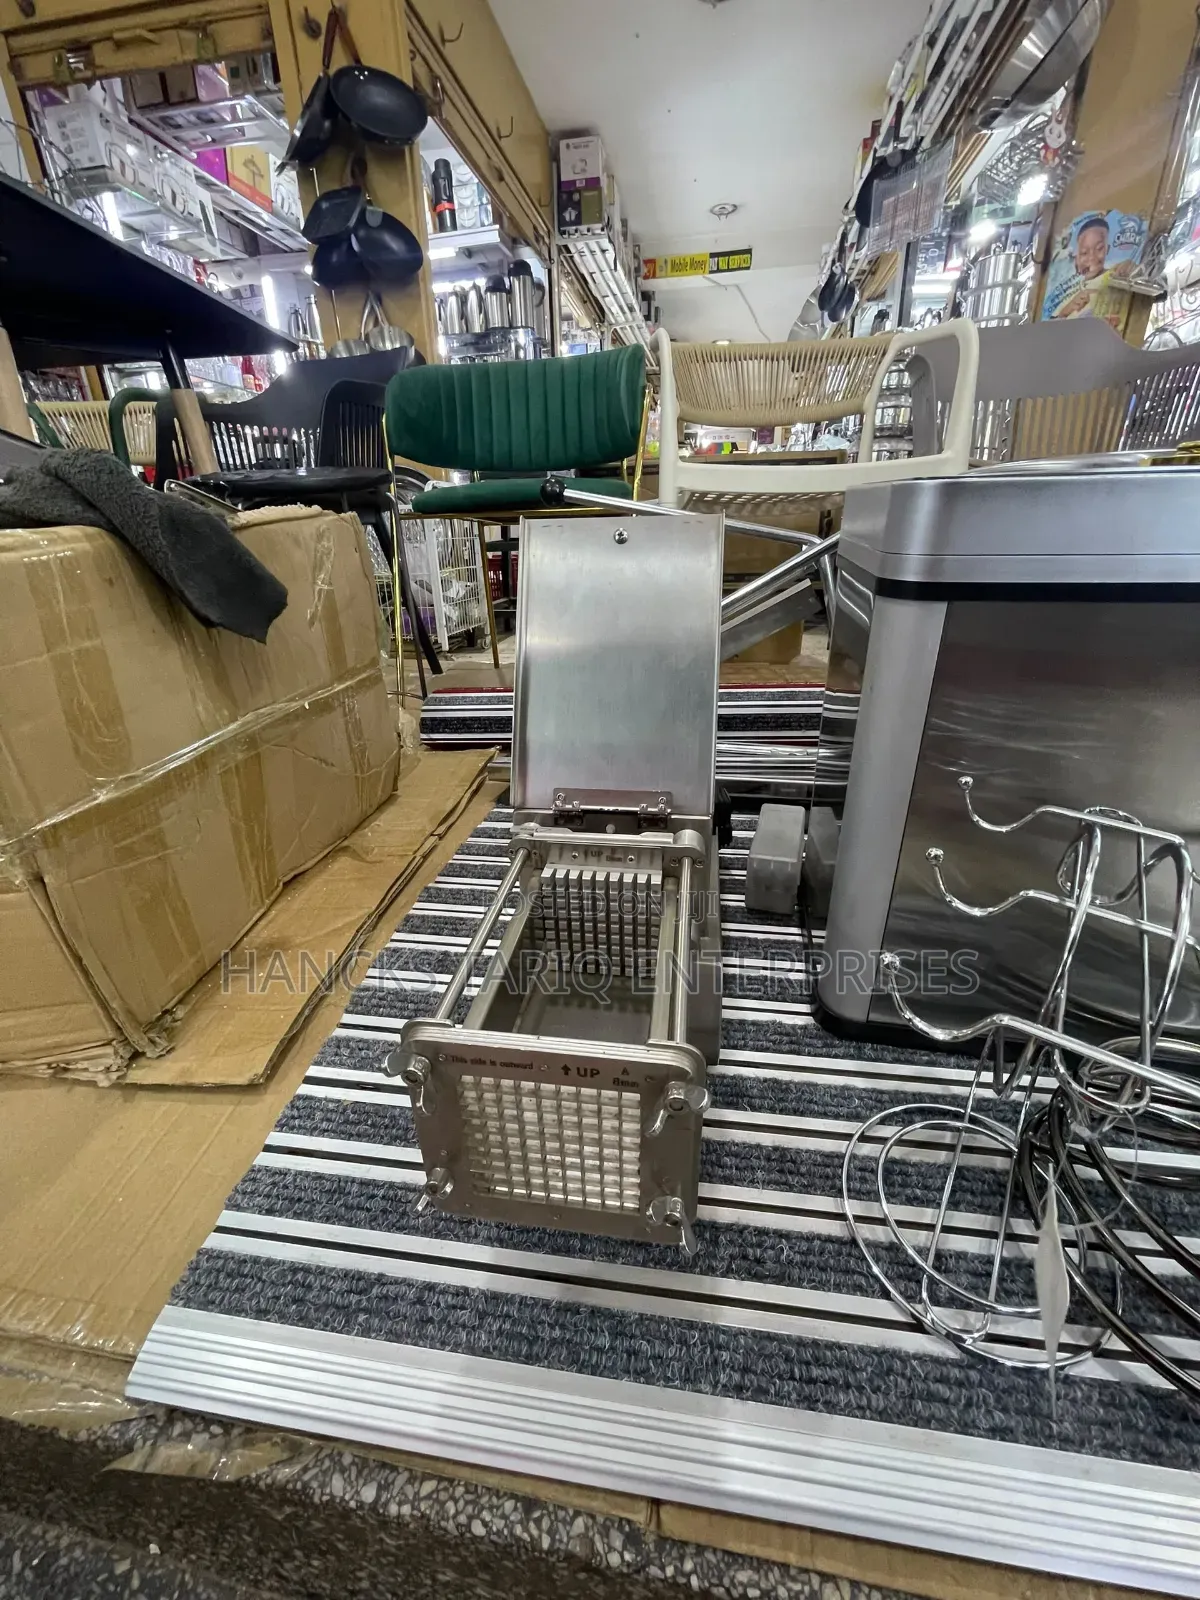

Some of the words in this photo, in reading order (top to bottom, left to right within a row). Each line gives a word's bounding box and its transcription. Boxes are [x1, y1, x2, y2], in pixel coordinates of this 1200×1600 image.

[670, 257, 689, 274] Mobile
[689, 256, 707, 274] Money
[590, 850, 603, 858] UP
[450, 1055, 468, 1064] This
[470, 1057, 487, 1065] side
[489, 1058, 497, 1067] is
[499, 1060, 534, 1070] outward
[576, 1067, 600, 1078] UP
